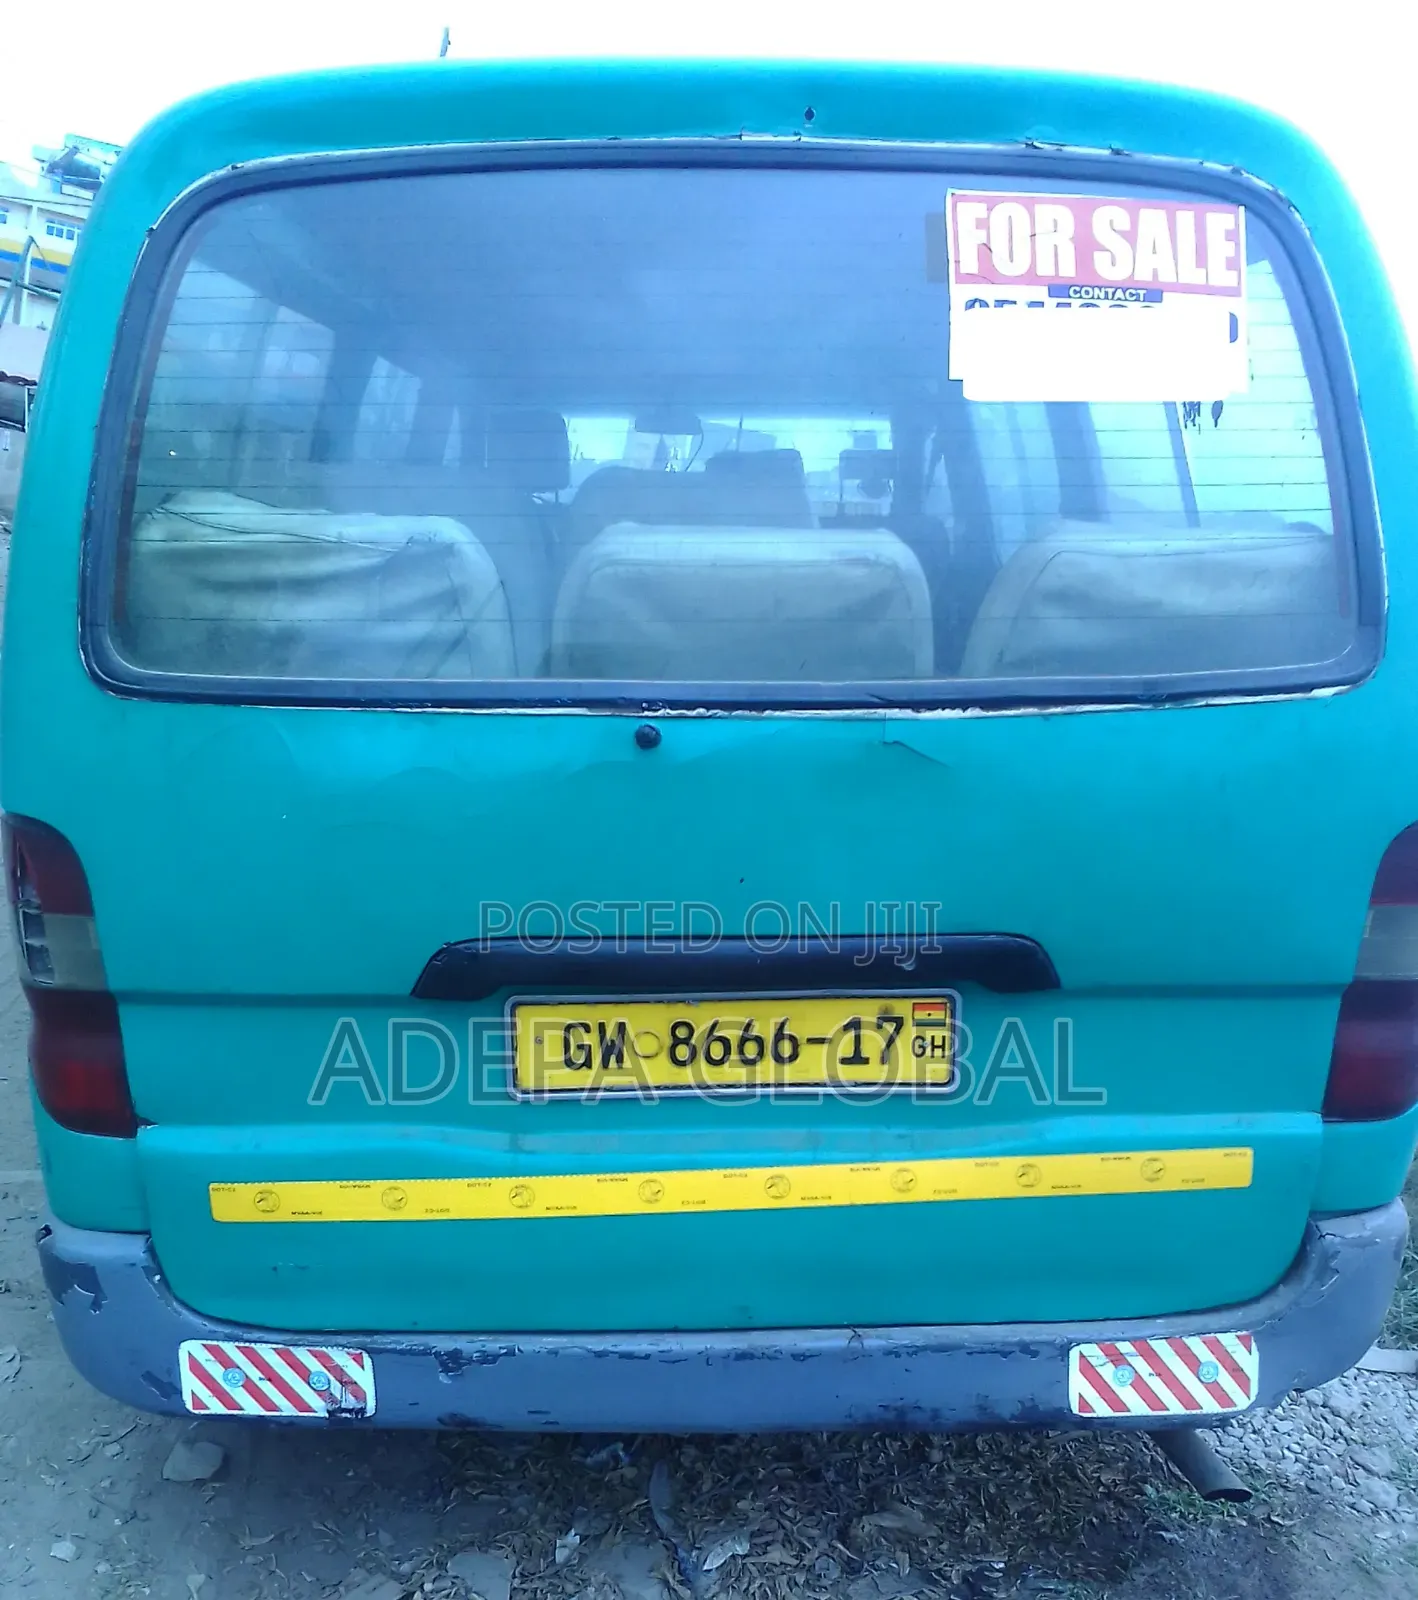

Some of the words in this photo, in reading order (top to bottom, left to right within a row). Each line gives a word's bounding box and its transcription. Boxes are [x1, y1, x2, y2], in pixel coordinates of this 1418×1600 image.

[956, 202, 1076, 278] FOR
[1091, 204, 1239, 287] SALE
[1068, 285, 1147, 302] CONTACT
[562, 1020, 627, 1070] GW
[668, 1015, 905, 1067] 8666-17
[911, 1035, 947, 1059] GH
